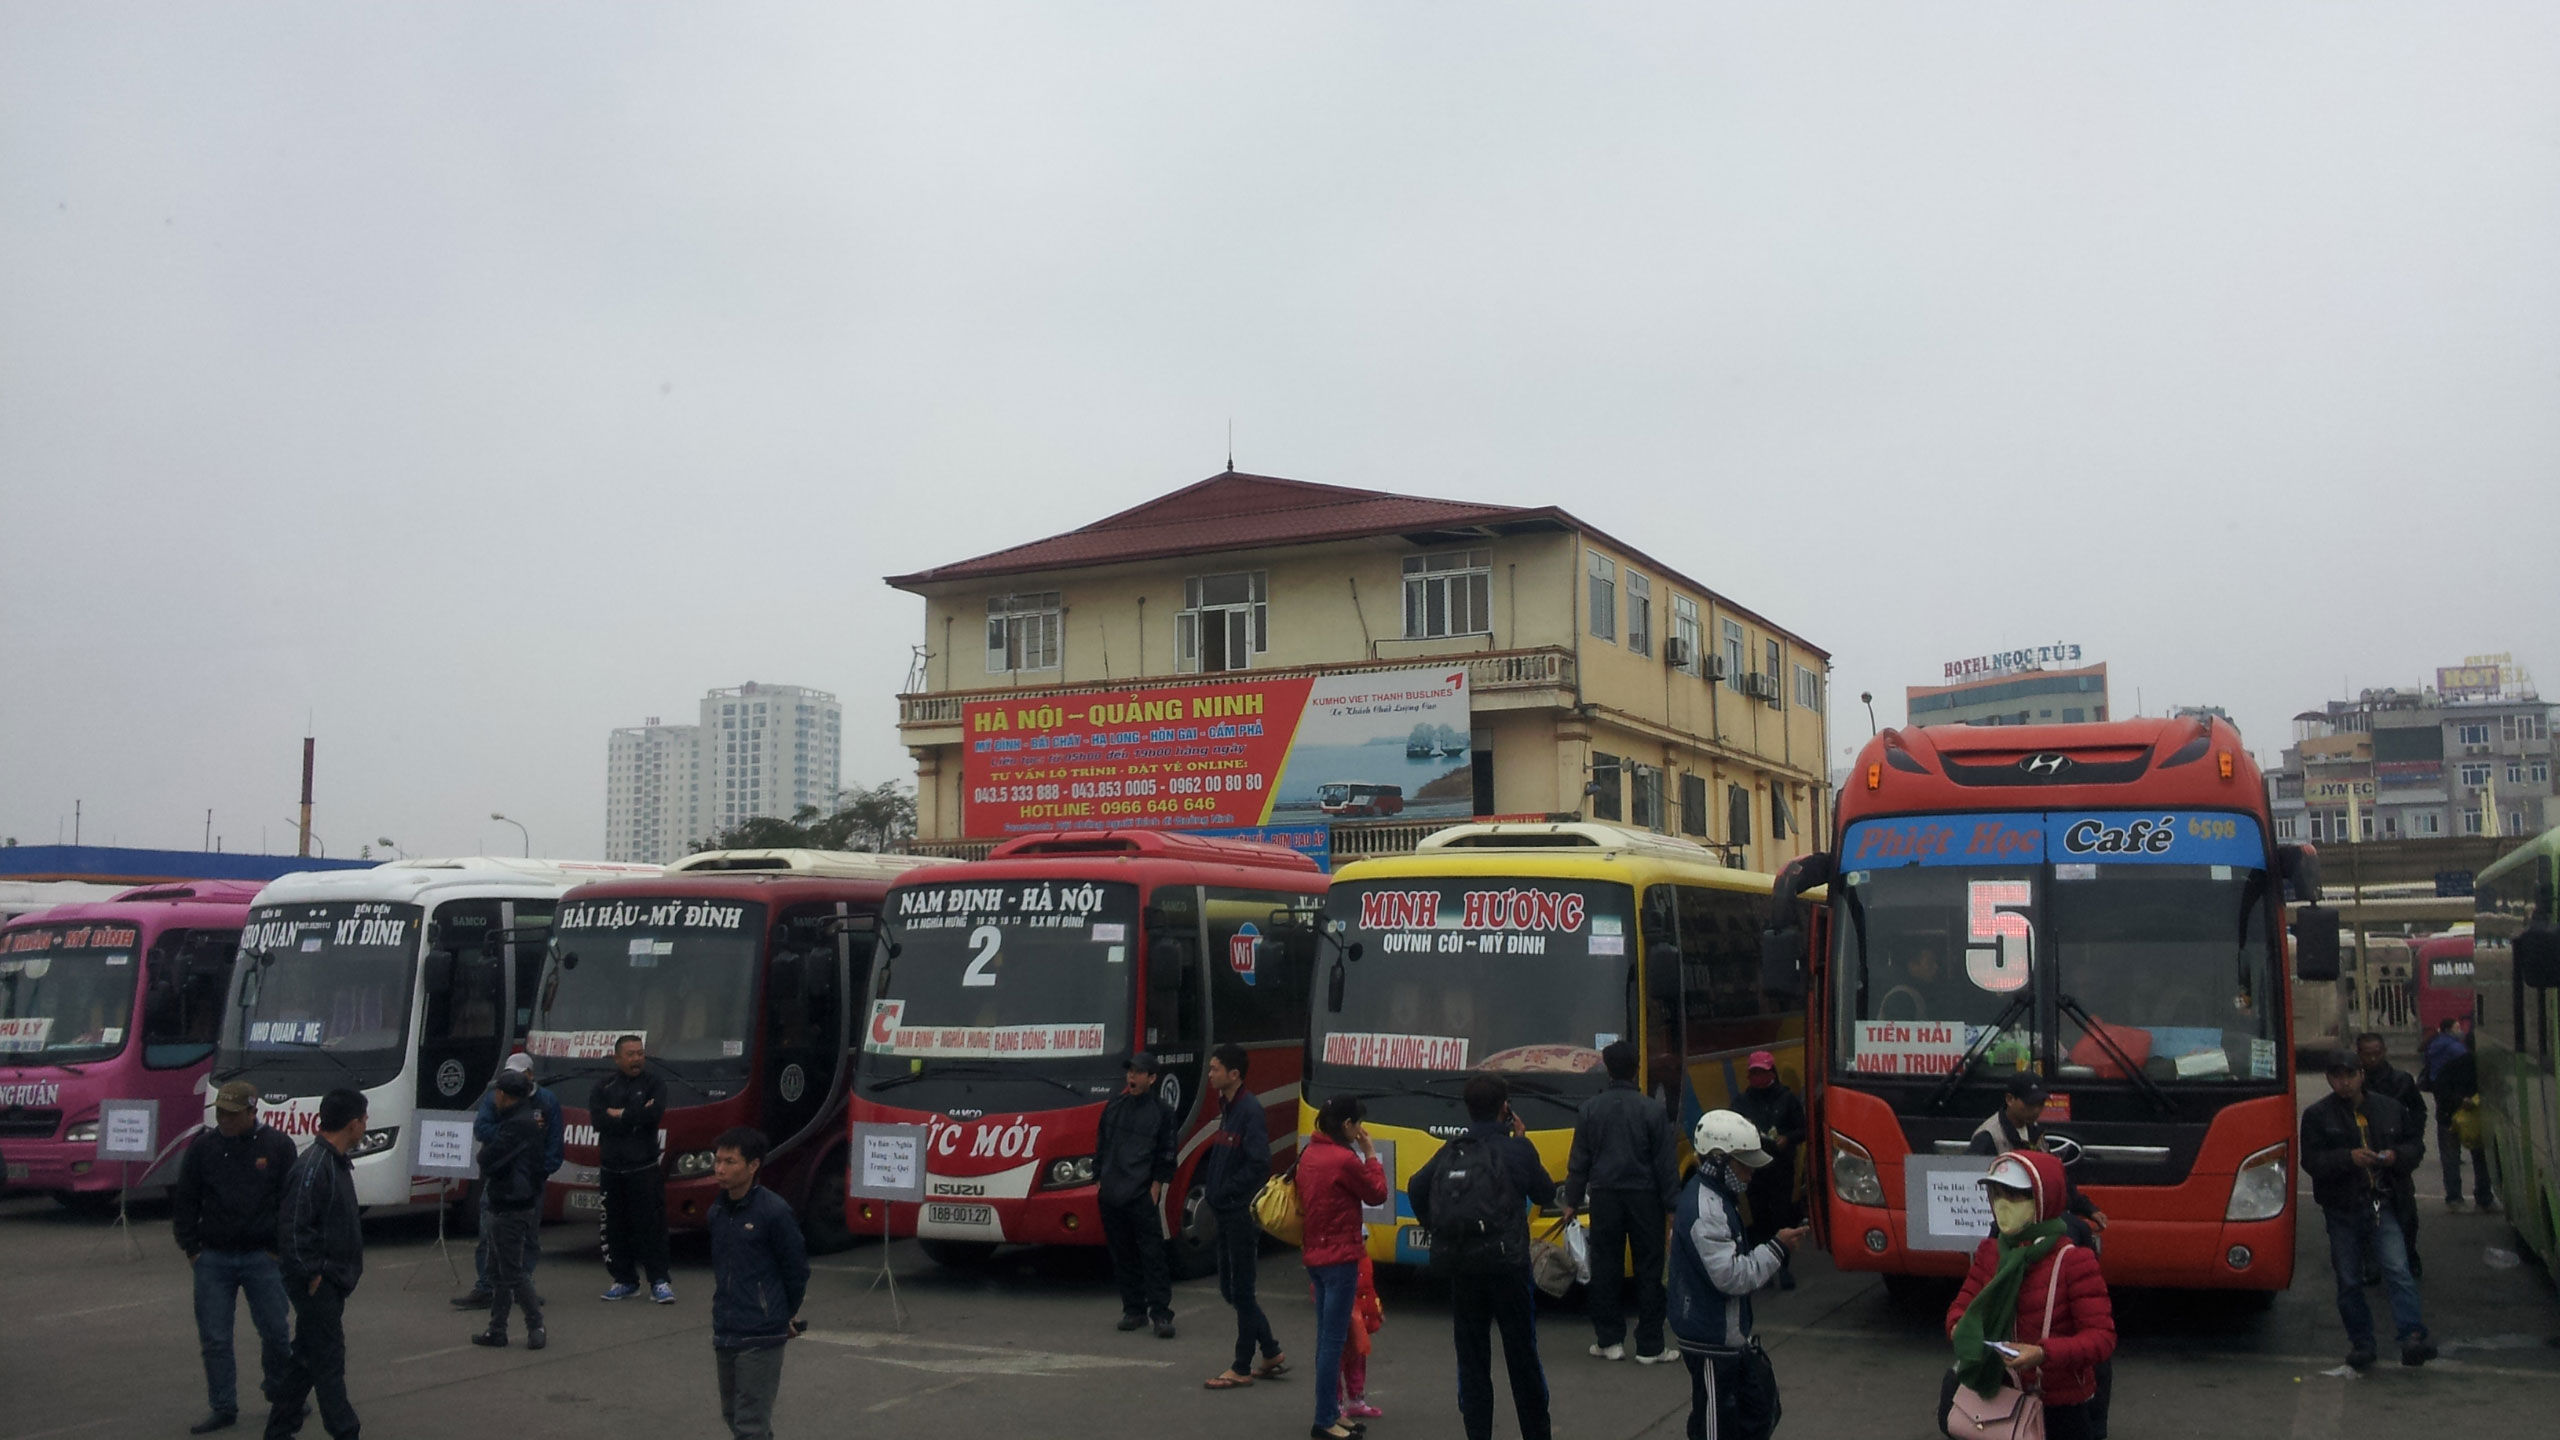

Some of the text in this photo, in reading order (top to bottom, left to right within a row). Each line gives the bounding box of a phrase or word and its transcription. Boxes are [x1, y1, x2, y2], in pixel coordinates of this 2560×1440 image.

[1944, 656, 1989, 678] HOTEL
[2039, 640, 2066, 662] TÚ
[2069, 644, 2081, 660] 3
[1312, 688, 1453, 706] KUMHO VIET THANH BUSLINES
[974, 693, 1264, 733] HÀ NỘI QUẢNG NINH
[1110, 729, 1141, 745] LONG
[1178, 728, 1198, 741] GAI
[1071, 764, 1117, 778] TRÌNH
[1187, 759, 1248, 772] ONLINE:
[1011, 785, 1034, 801] 333
[1036, 783, 1060, 800] 888
[1071, 780, 1122, 799] 043.853
[1125, 778, 1157, 796] 0005
[1169, 776, 1201, 794] 0962
[1204, 775, 1222, 792] 00
[1225, 774, 1242, 792] 80
[1246, 773, 1263, 790] 80
[1020, 797, 1216, 818] HOTLINE: 0966 646 646
[2064, 816, 2175, 854] Café
[900, 882, 1104, 916] NAM ĐỊNH HÀ NỘI
[1359, 891, 1440, 930] MINH
[1463, 888, 1584, 932] HƯƠNG
[561, 902, 595, 929] HẢI
[684, 901, 743, 928] ĐÌNH
[259, 920, 300, 954] QUAN
[360, 914, 405, 946] ĐÌNH
[1384, 932, 1546, 954] QUỲNH CÔI MỸ ĐÌNH
[1966, 881, 2035, 992] 5
[962, 925, 1002, 986] 2
[270, 1022, 298, 1044] QUAN
[1053, 1030, 1076, 1049] NAM
[1917, 1021, 1951, 1043] HẢI
[1857, 1053, 1898, 1073] NAM
[969, 1115, 1042, 1158] MỚI
[934, 1184, 985, 1196] ISUZU
